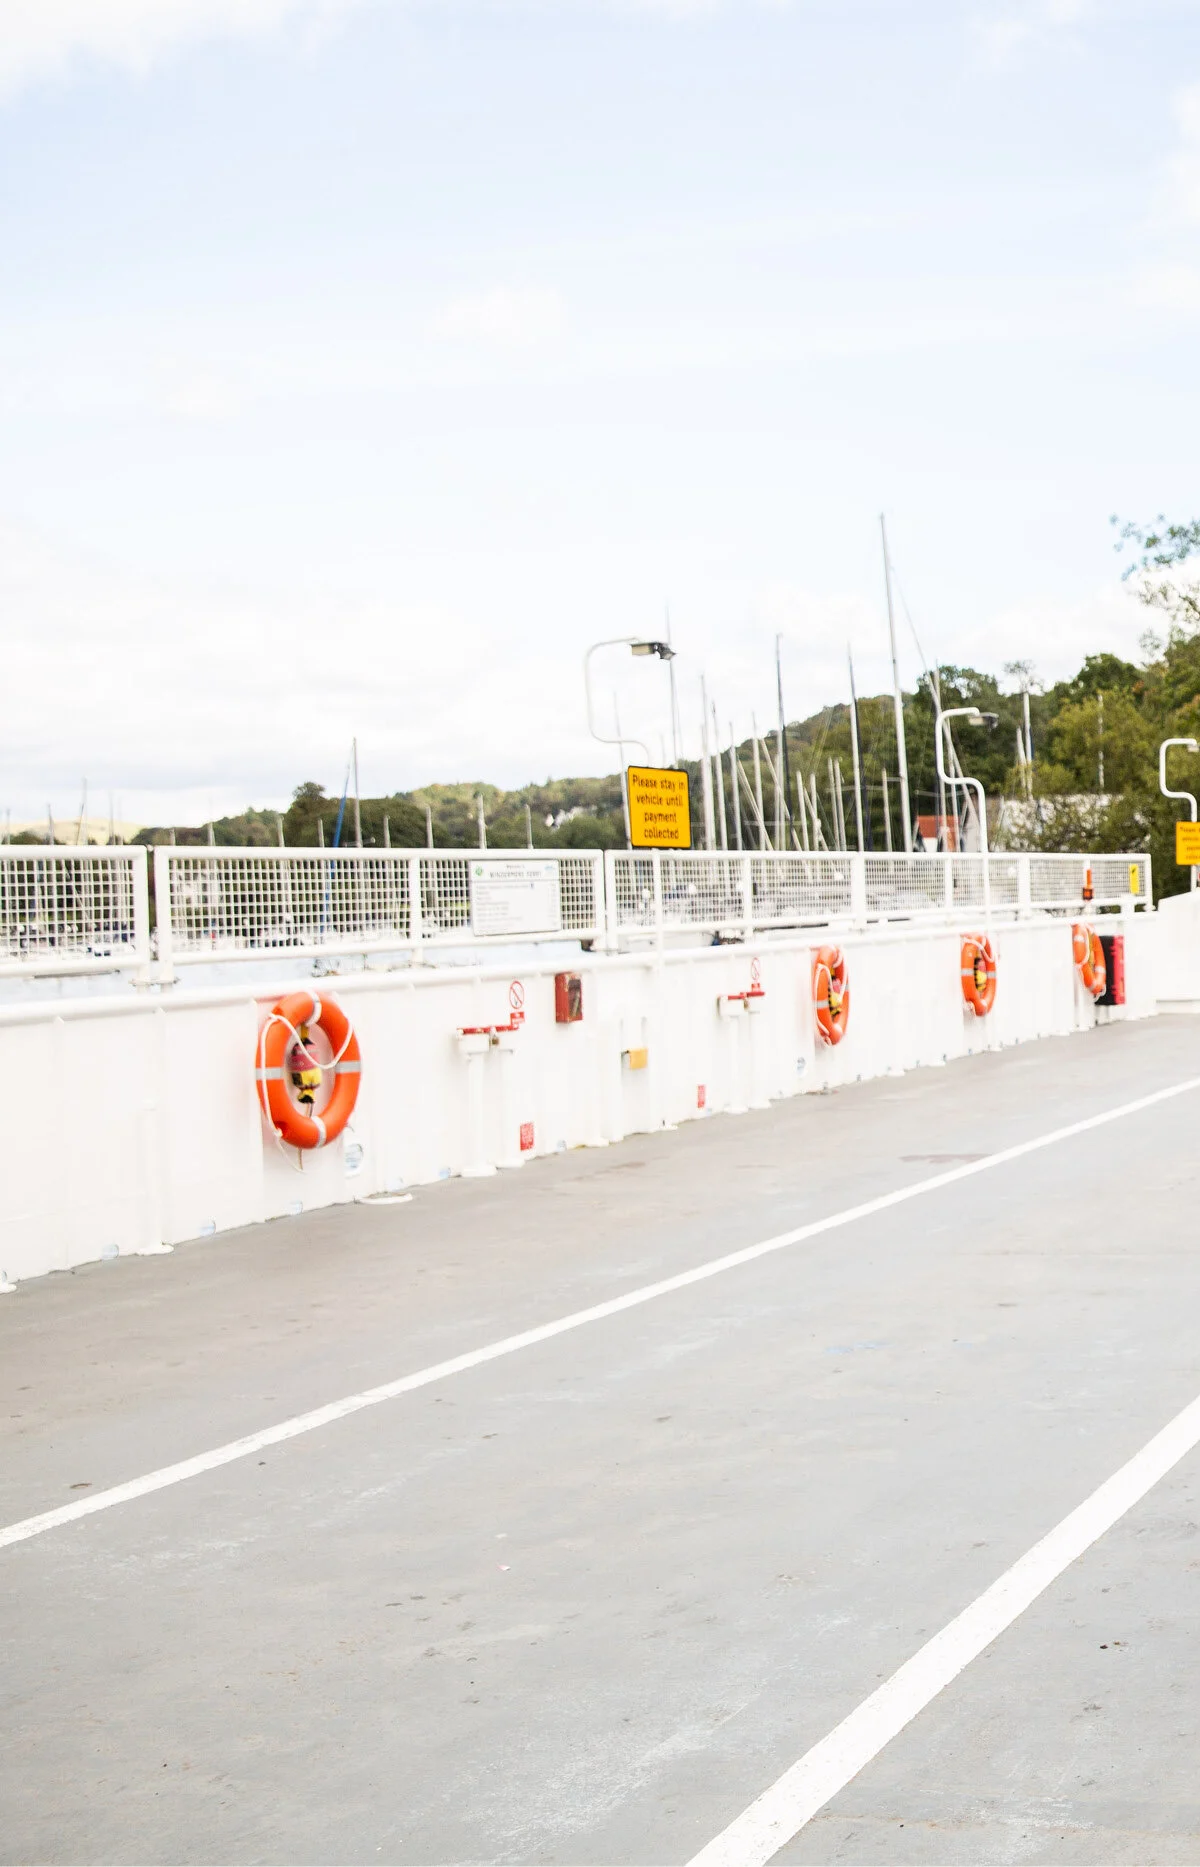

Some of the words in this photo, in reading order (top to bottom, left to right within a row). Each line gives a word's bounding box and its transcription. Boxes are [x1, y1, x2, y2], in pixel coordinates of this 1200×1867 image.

[632, 774, 657, 788] Please
[660, 778, 676, 792] stay
[679, 781, 686, 790] in
[636, 793, 663, 806] vehicle
[666, 795, 684, 807] until
[644, 812, 677, 824] payment
[644, 826, 680, 840] collected
